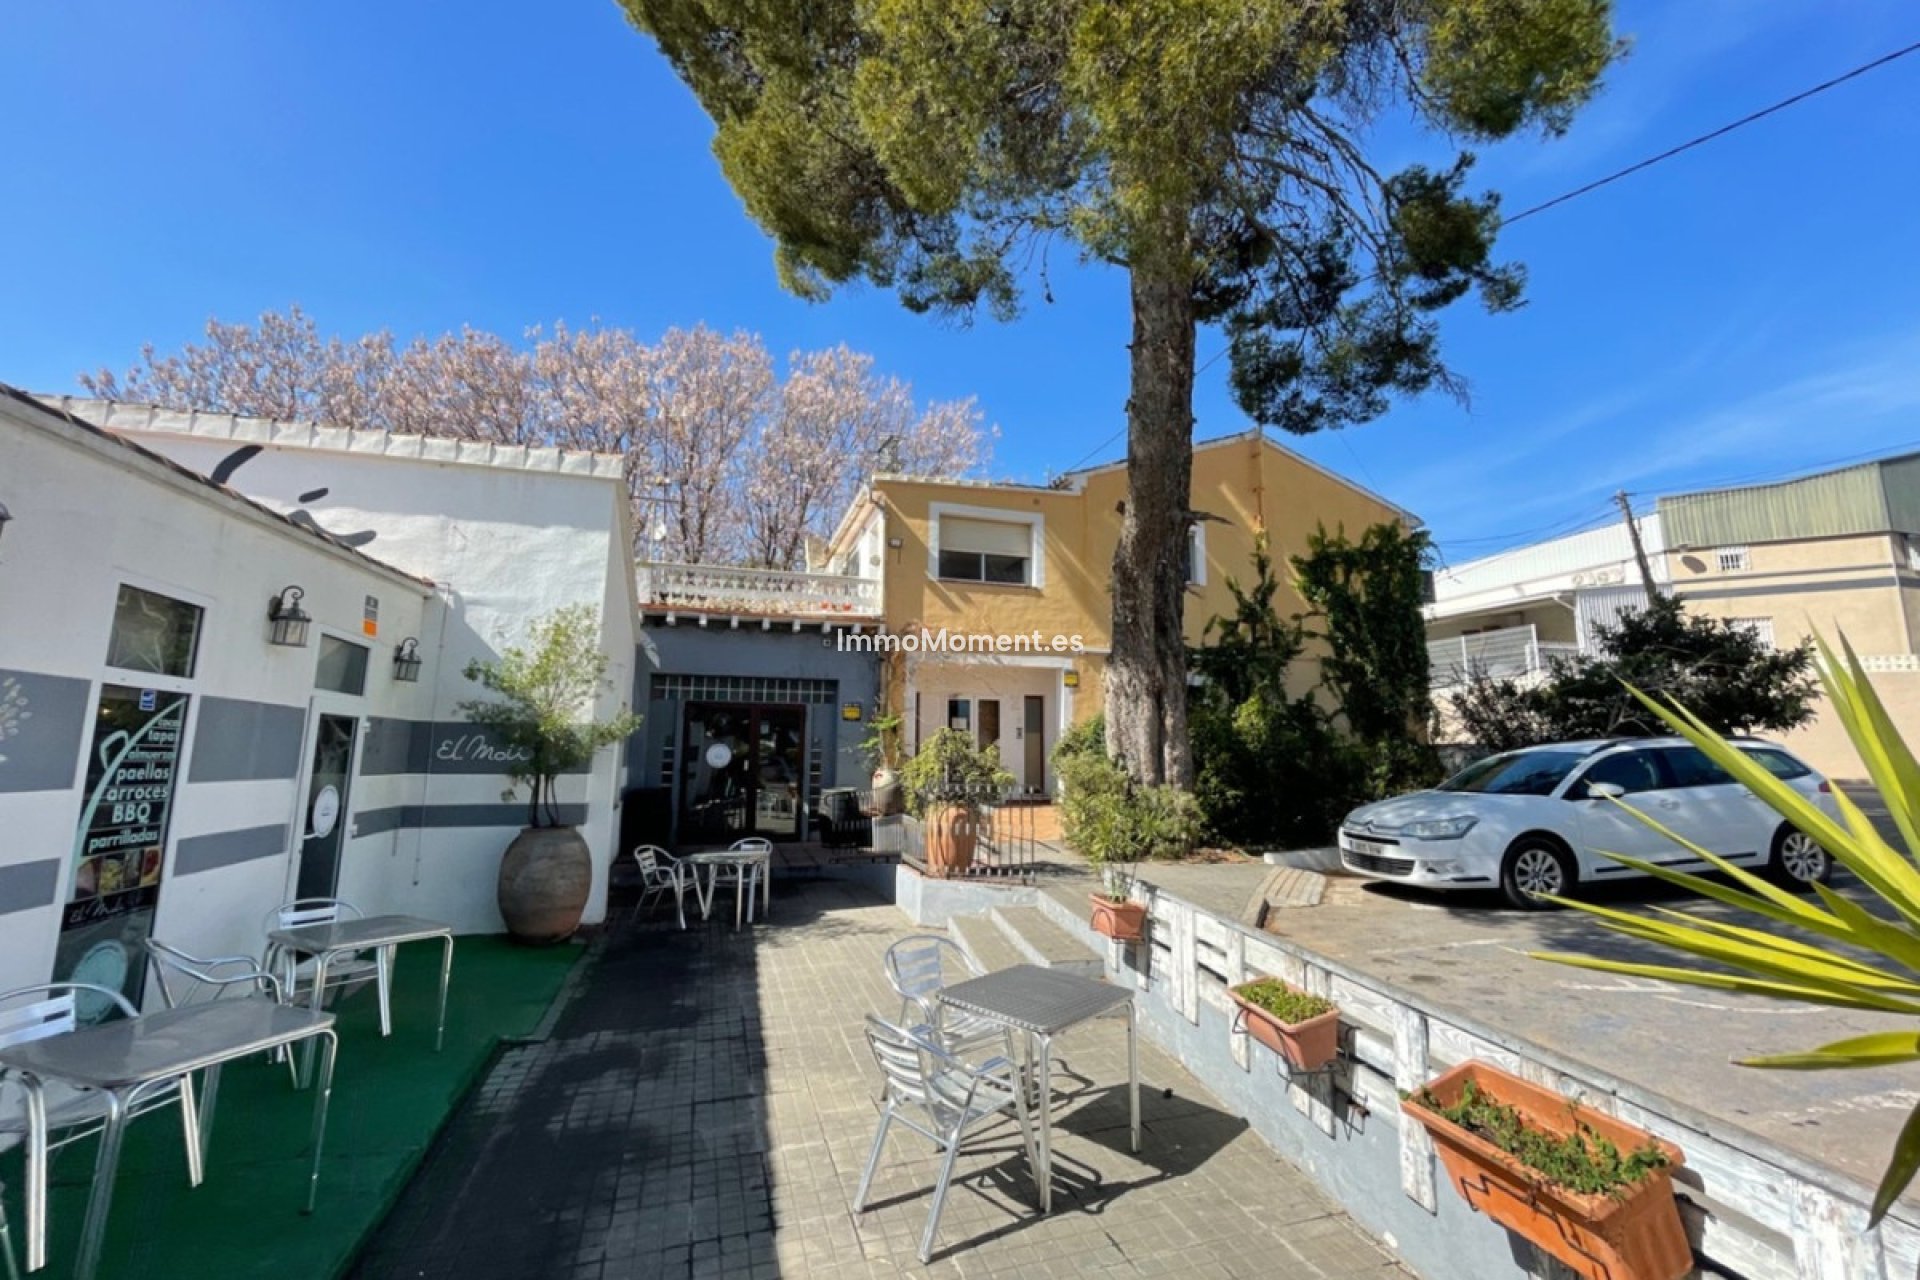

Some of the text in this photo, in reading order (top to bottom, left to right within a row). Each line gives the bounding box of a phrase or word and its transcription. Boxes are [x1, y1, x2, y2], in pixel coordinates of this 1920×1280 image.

[436, 734, 466, 761] El
[115, 761, 169, 786] paellas
[106, 785, 168, 801] arroces
[112, 802, 151, 824] BBQ
[88, 827, 158, 854] parrilladas
